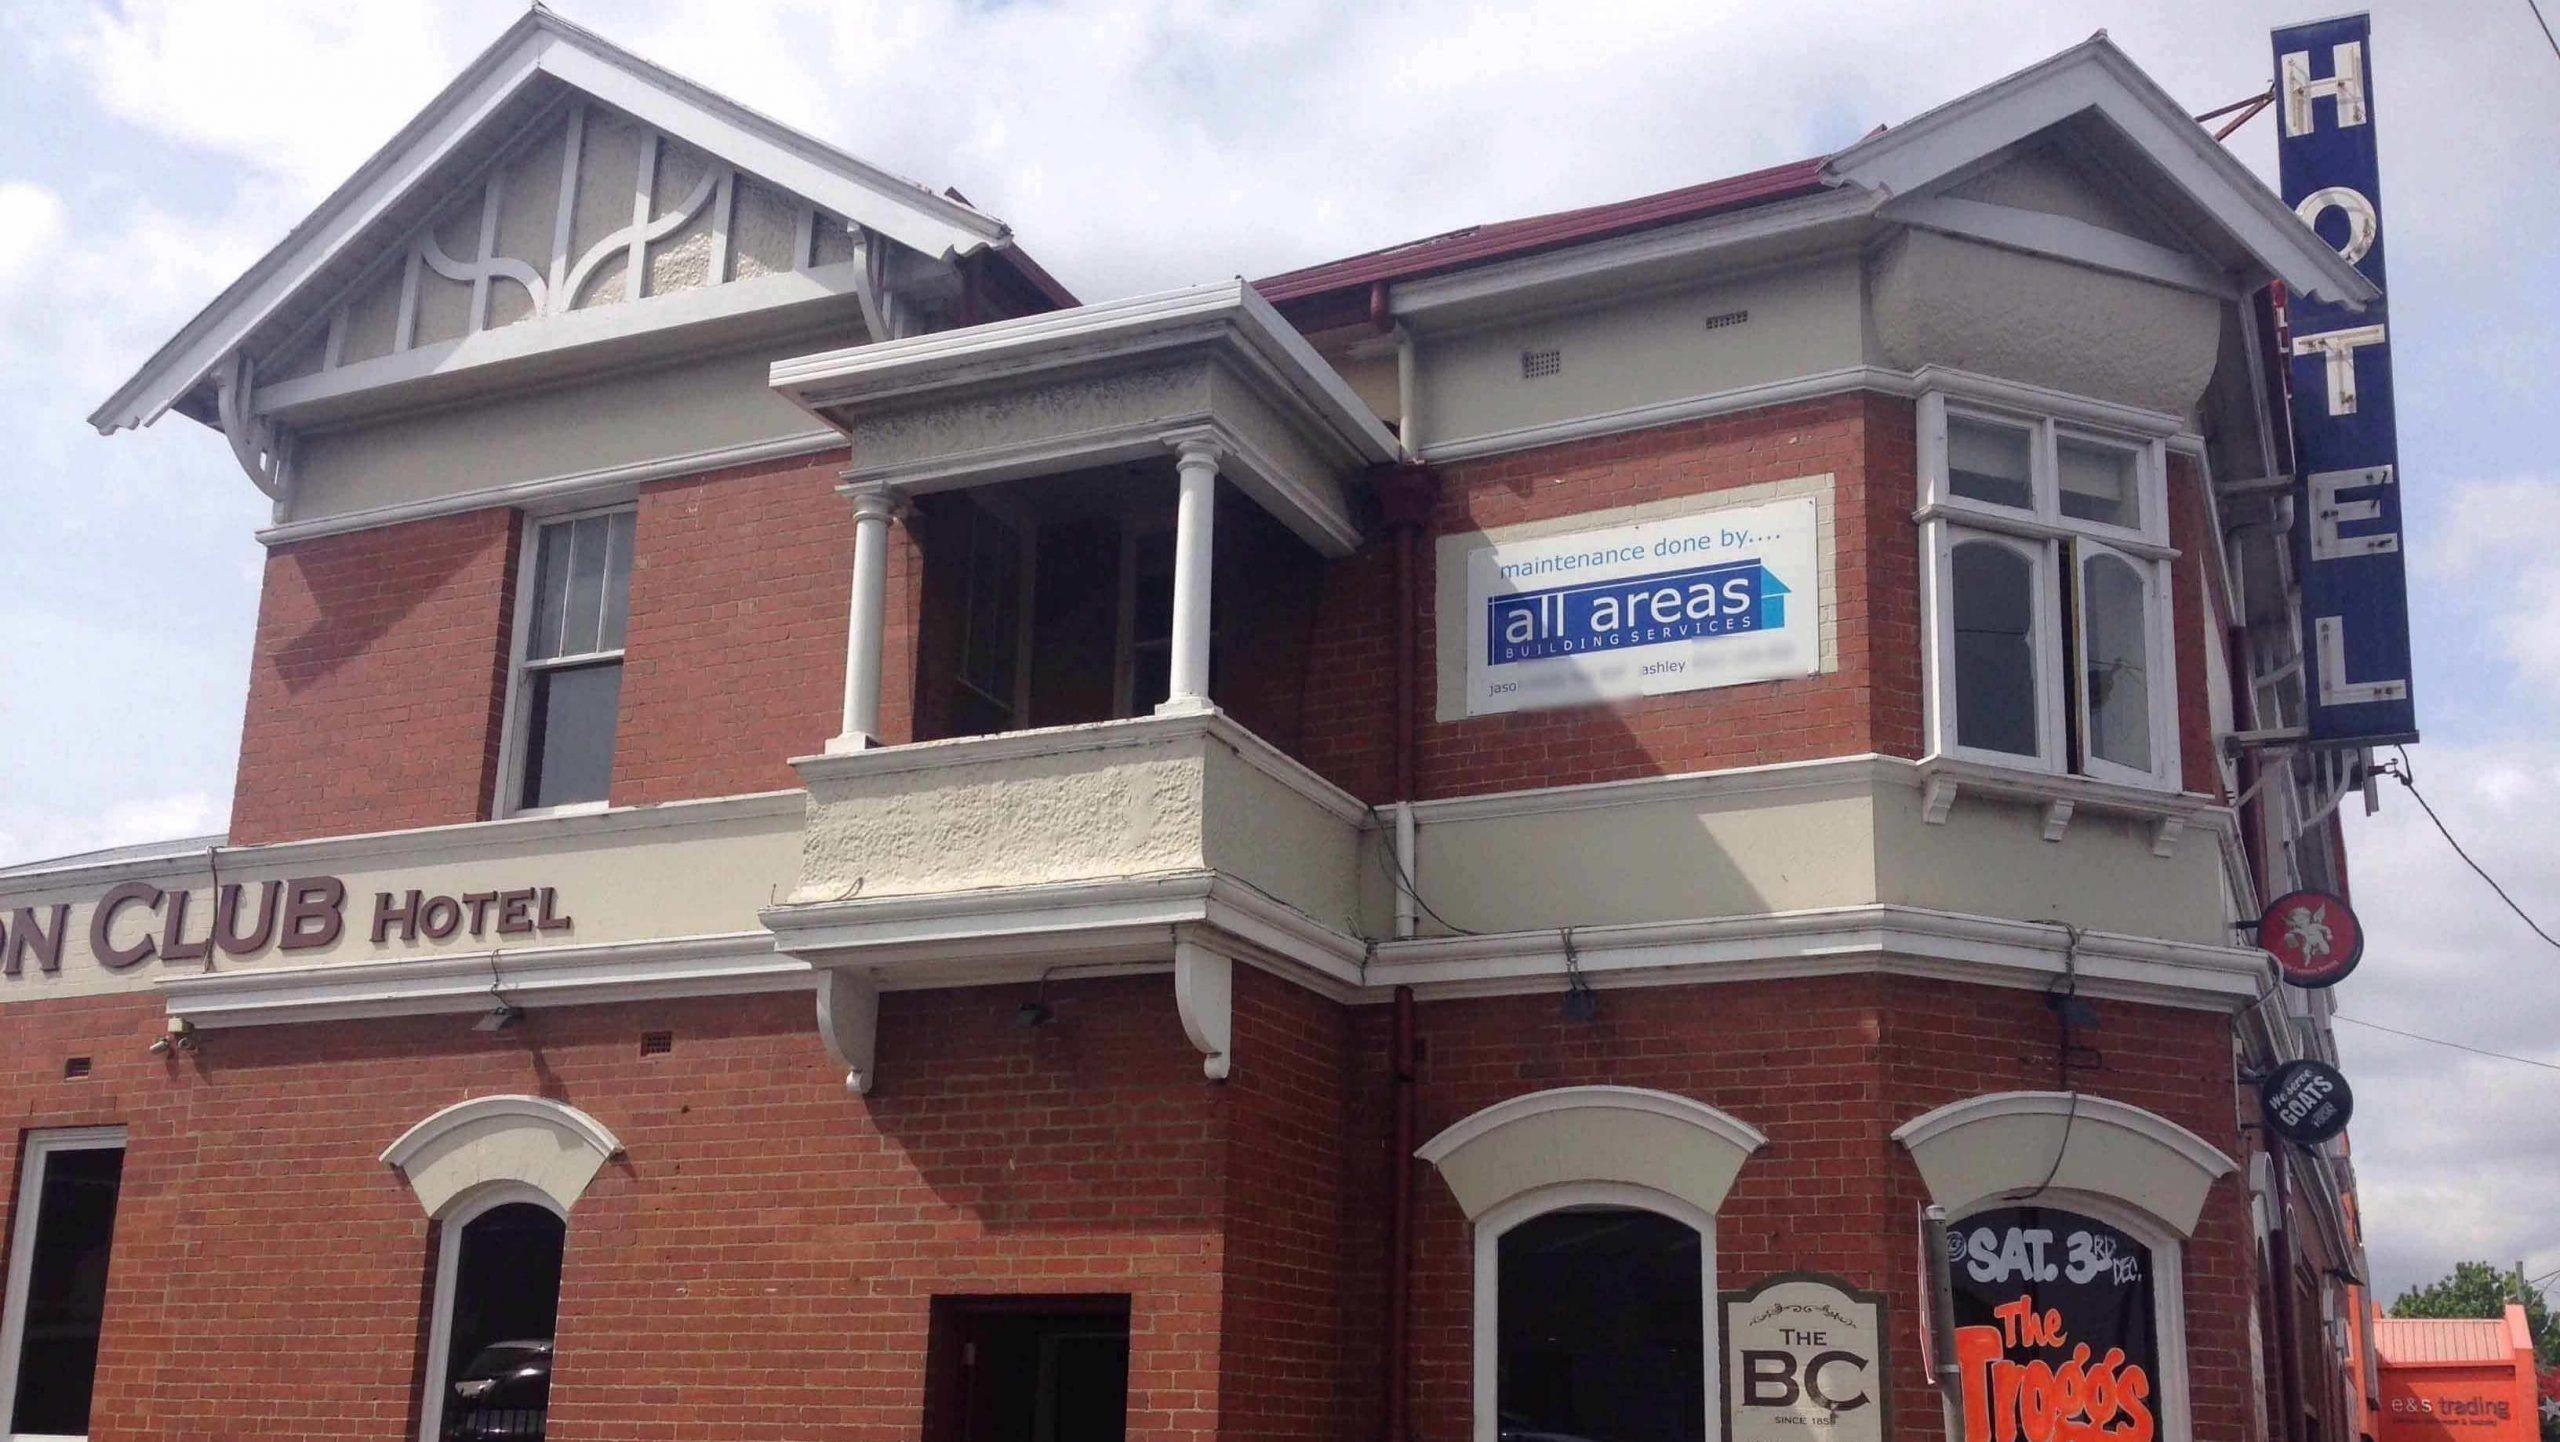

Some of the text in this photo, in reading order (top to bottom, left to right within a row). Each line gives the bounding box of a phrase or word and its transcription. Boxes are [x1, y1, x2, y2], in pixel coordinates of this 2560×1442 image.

[2281, 41, 2407, 707] HOTEL
[1501, 545, 1645, 579] maintenance
[1654, 533, 1711, 557] done
[1505, 577, 1751, 644] all areas
[1506, 616, 1751, 659] BUILDING SERVICES
[1642, 660, 1686, 677] ashley
[0, 875, 572, 975] N CLUB HOTEL
[2269, 1068, 2313, 1110] We serve
[2279, 1075, 2334, 1127] GOATS
[1967, 1227, 2059, 1283] SAT.
[1779, 1328, 1828, 1346] THE
[1994, 1294, 2068, 1348] The
[1740, 1349, 1871, 1412] BC
[1955, 1325, 2155, 1442] Troggs
[1775, 1415, 1807, 1425] SINCE
[2438, 1395, 2511, 1420] trading
